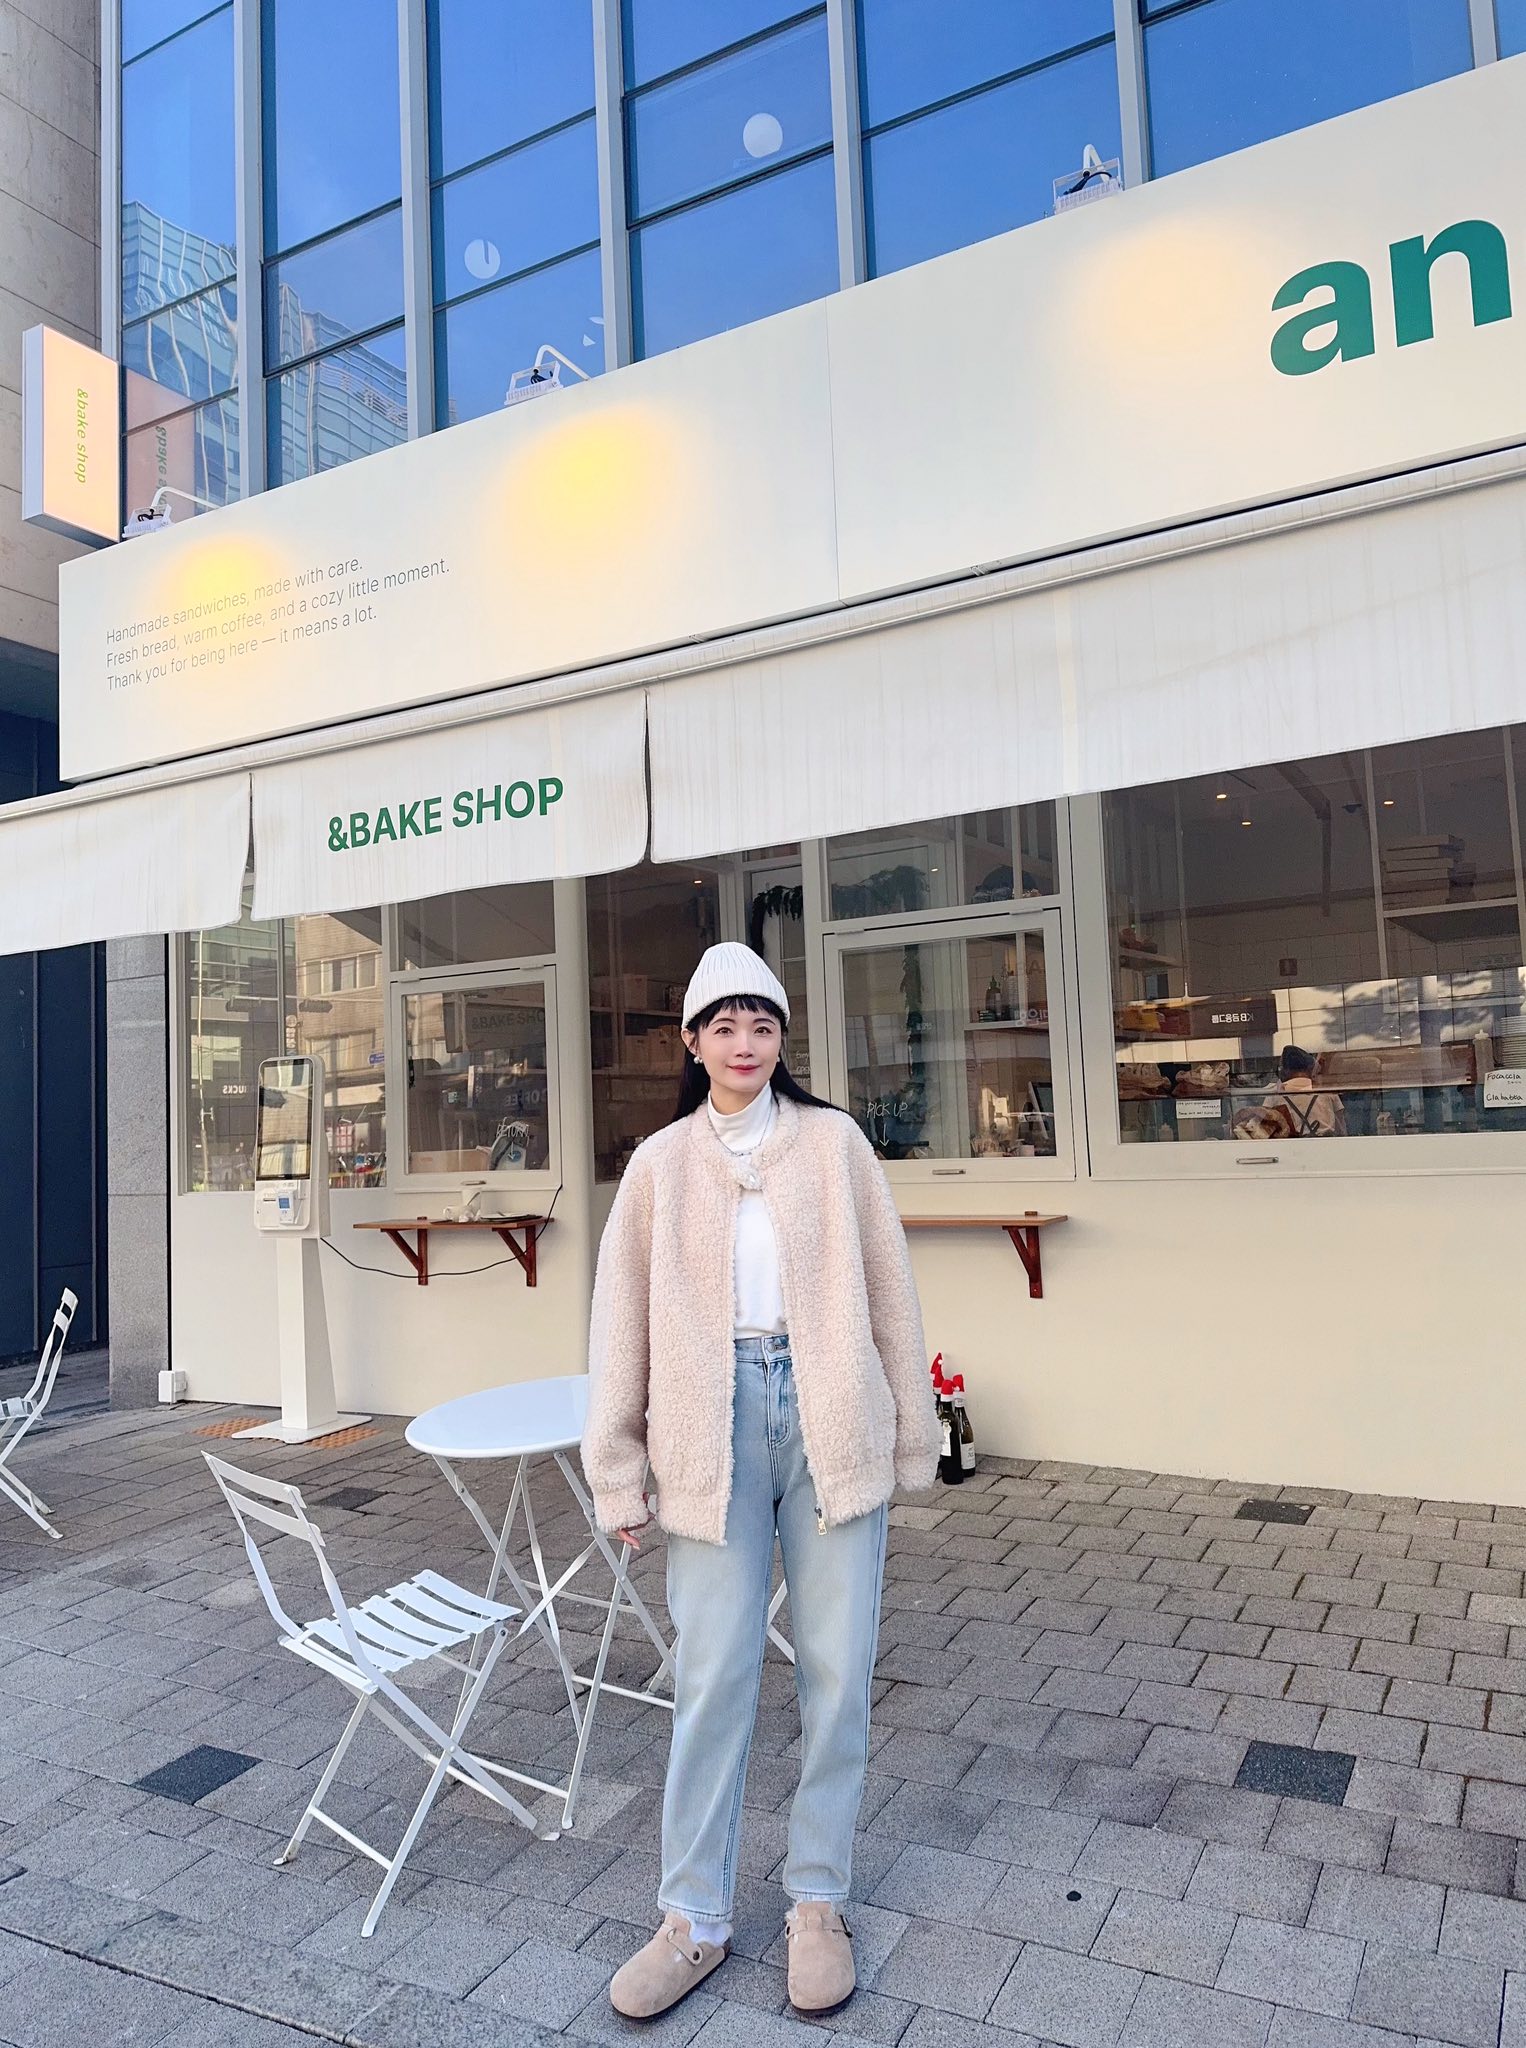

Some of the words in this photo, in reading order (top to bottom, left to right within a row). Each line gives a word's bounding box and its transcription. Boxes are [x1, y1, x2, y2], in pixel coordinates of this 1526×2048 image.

[1271, 219, 1512, 376] an
[77, 388, 88, 439] &bake
[74, 445, 88, 483] shop
[106, 615, 170, 645] Handmade
[173, 592, 250, 625] sandwiches,
[254, 578, 291, 601] made
[295, 567, 324, 588] with
[328, 558, 363, 579] care.
[106, 647, 139, 669] Fresh
[142, 634, 180, 658] bread,
[184, 625, 218, 646] warm
[221, 612, 266, 635] coffee,
[270, 602, 295, 621] and
[299, 600, 307, 613] a
[311, 589, 345, 609] cozy
[349, 577, 379, 600] little
[384, 558, 450, 590] moment.
[107, 668, 143, 691] Thank
[145, 663, 167, 685] you
[171, 657, 188, 673] for
[191, 649, 226, 668] being
[229, 639, 258, 657] here
[280, 628, 288, 644] it
[292, 617, 338, 641] means
[342, 613, 350, 627] a
[355, 605, 377, 624] lot.
[328, 796, 442, 852] &BAKE
[452, 777, 564, 828] SHOP
[866, 1102, 890, 1118] PICK
[893, 1101, 909, 1118] UP
